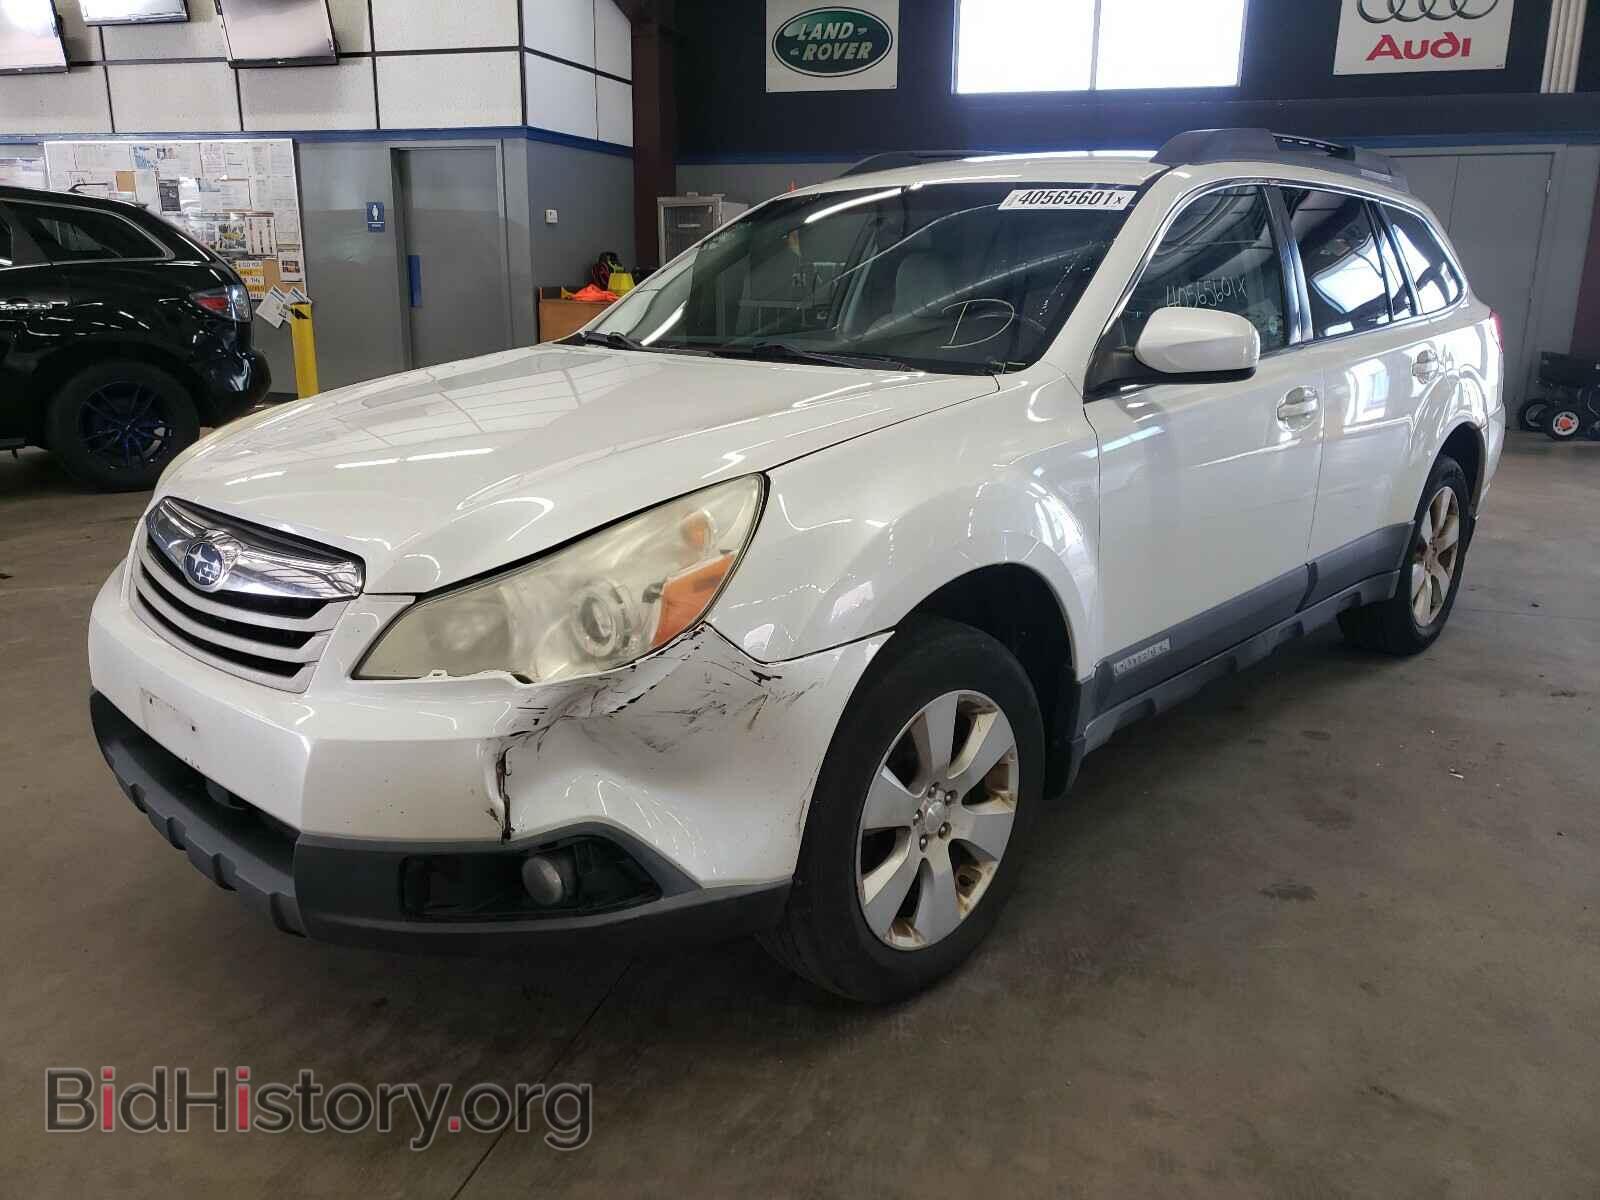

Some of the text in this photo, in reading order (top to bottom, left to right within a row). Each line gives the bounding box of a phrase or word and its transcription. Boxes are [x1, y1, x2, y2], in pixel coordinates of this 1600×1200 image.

[797, 22, 854, 41] LAND
[802, 42, 873, 61] ROVER
[1365, 31, 1472, 61] Audi
